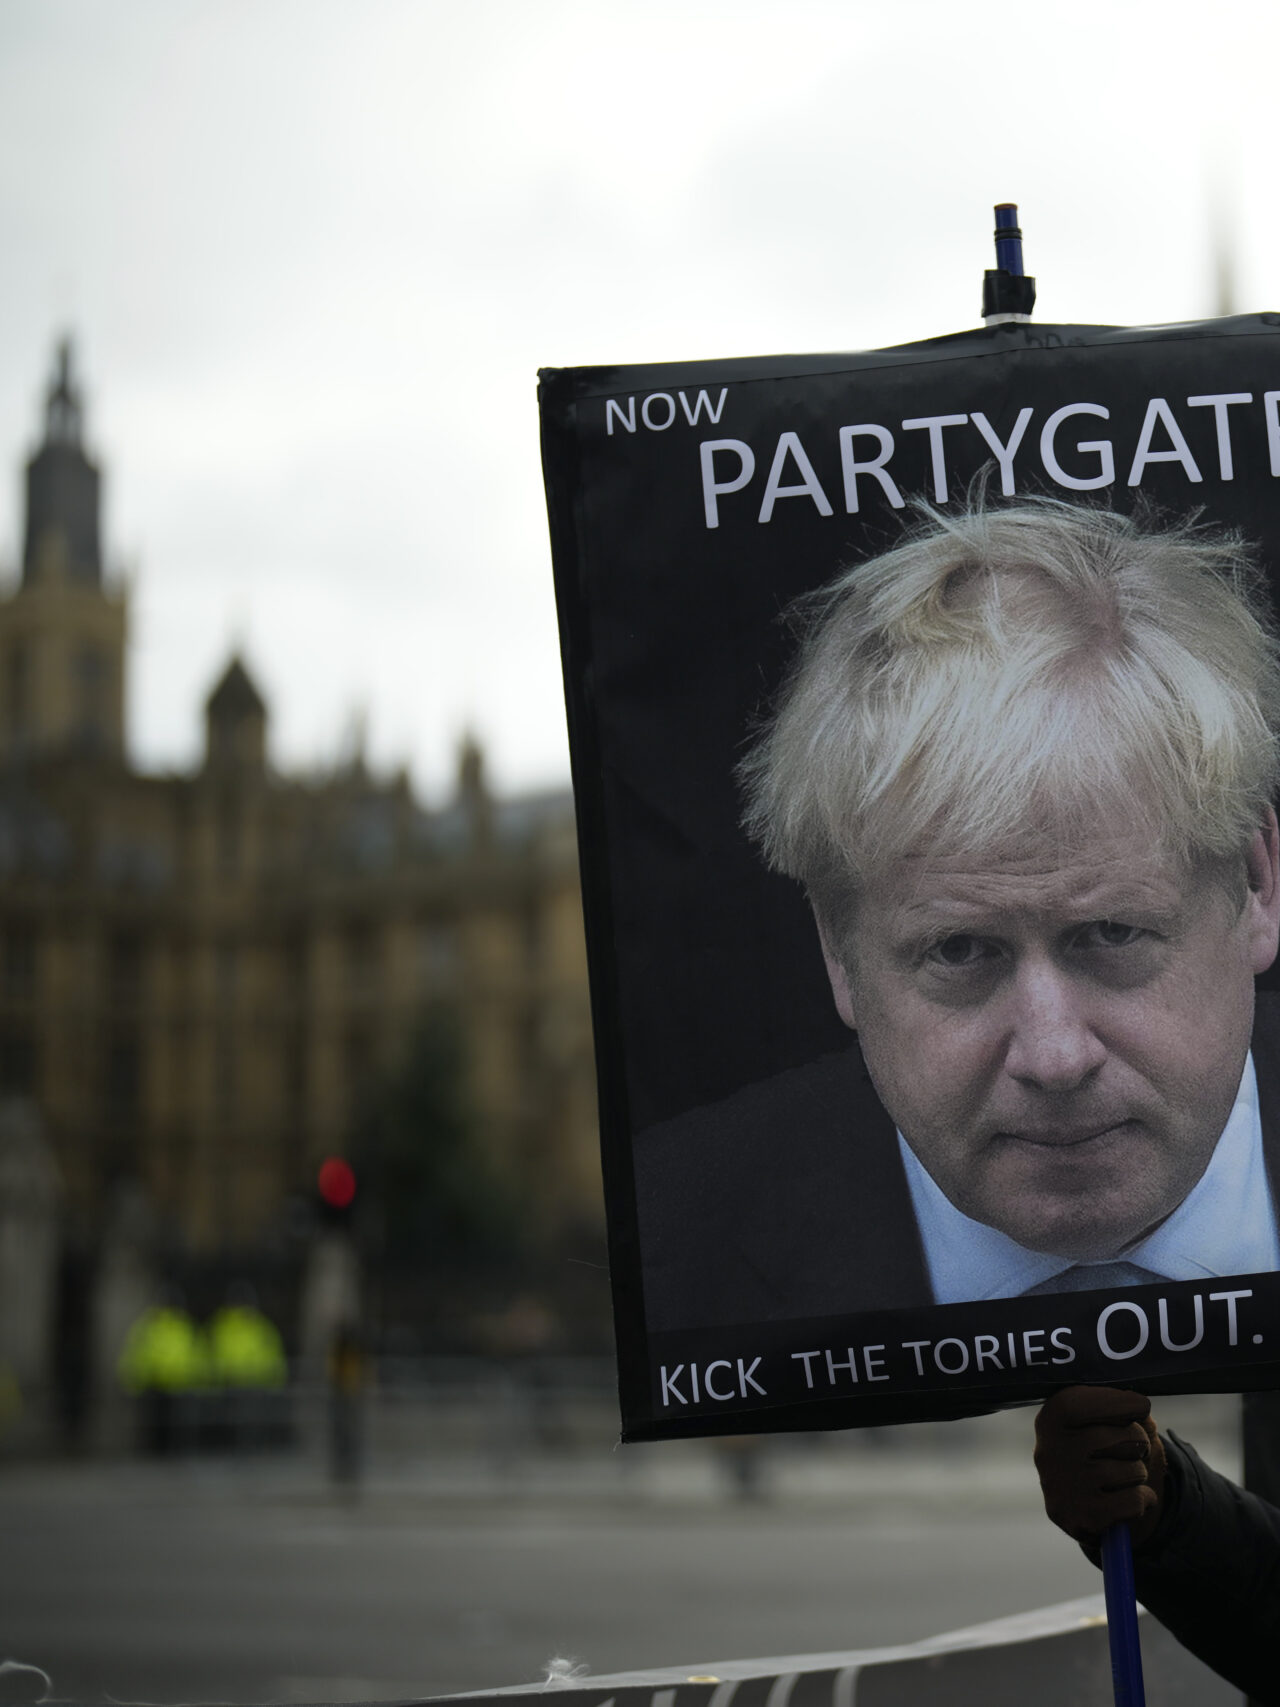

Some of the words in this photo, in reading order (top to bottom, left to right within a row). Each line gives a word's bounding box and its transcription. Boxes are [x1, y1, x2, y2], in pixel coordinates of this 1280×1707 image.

[605, 387, 729, 435] NOW
[660, 1356, 767, 1406] KICK
[791, 1344, 890, 1389] THE
[902, 1326, 1077, 1376] TORIES
[1095, 1290, 1264, 1361] OUT.
